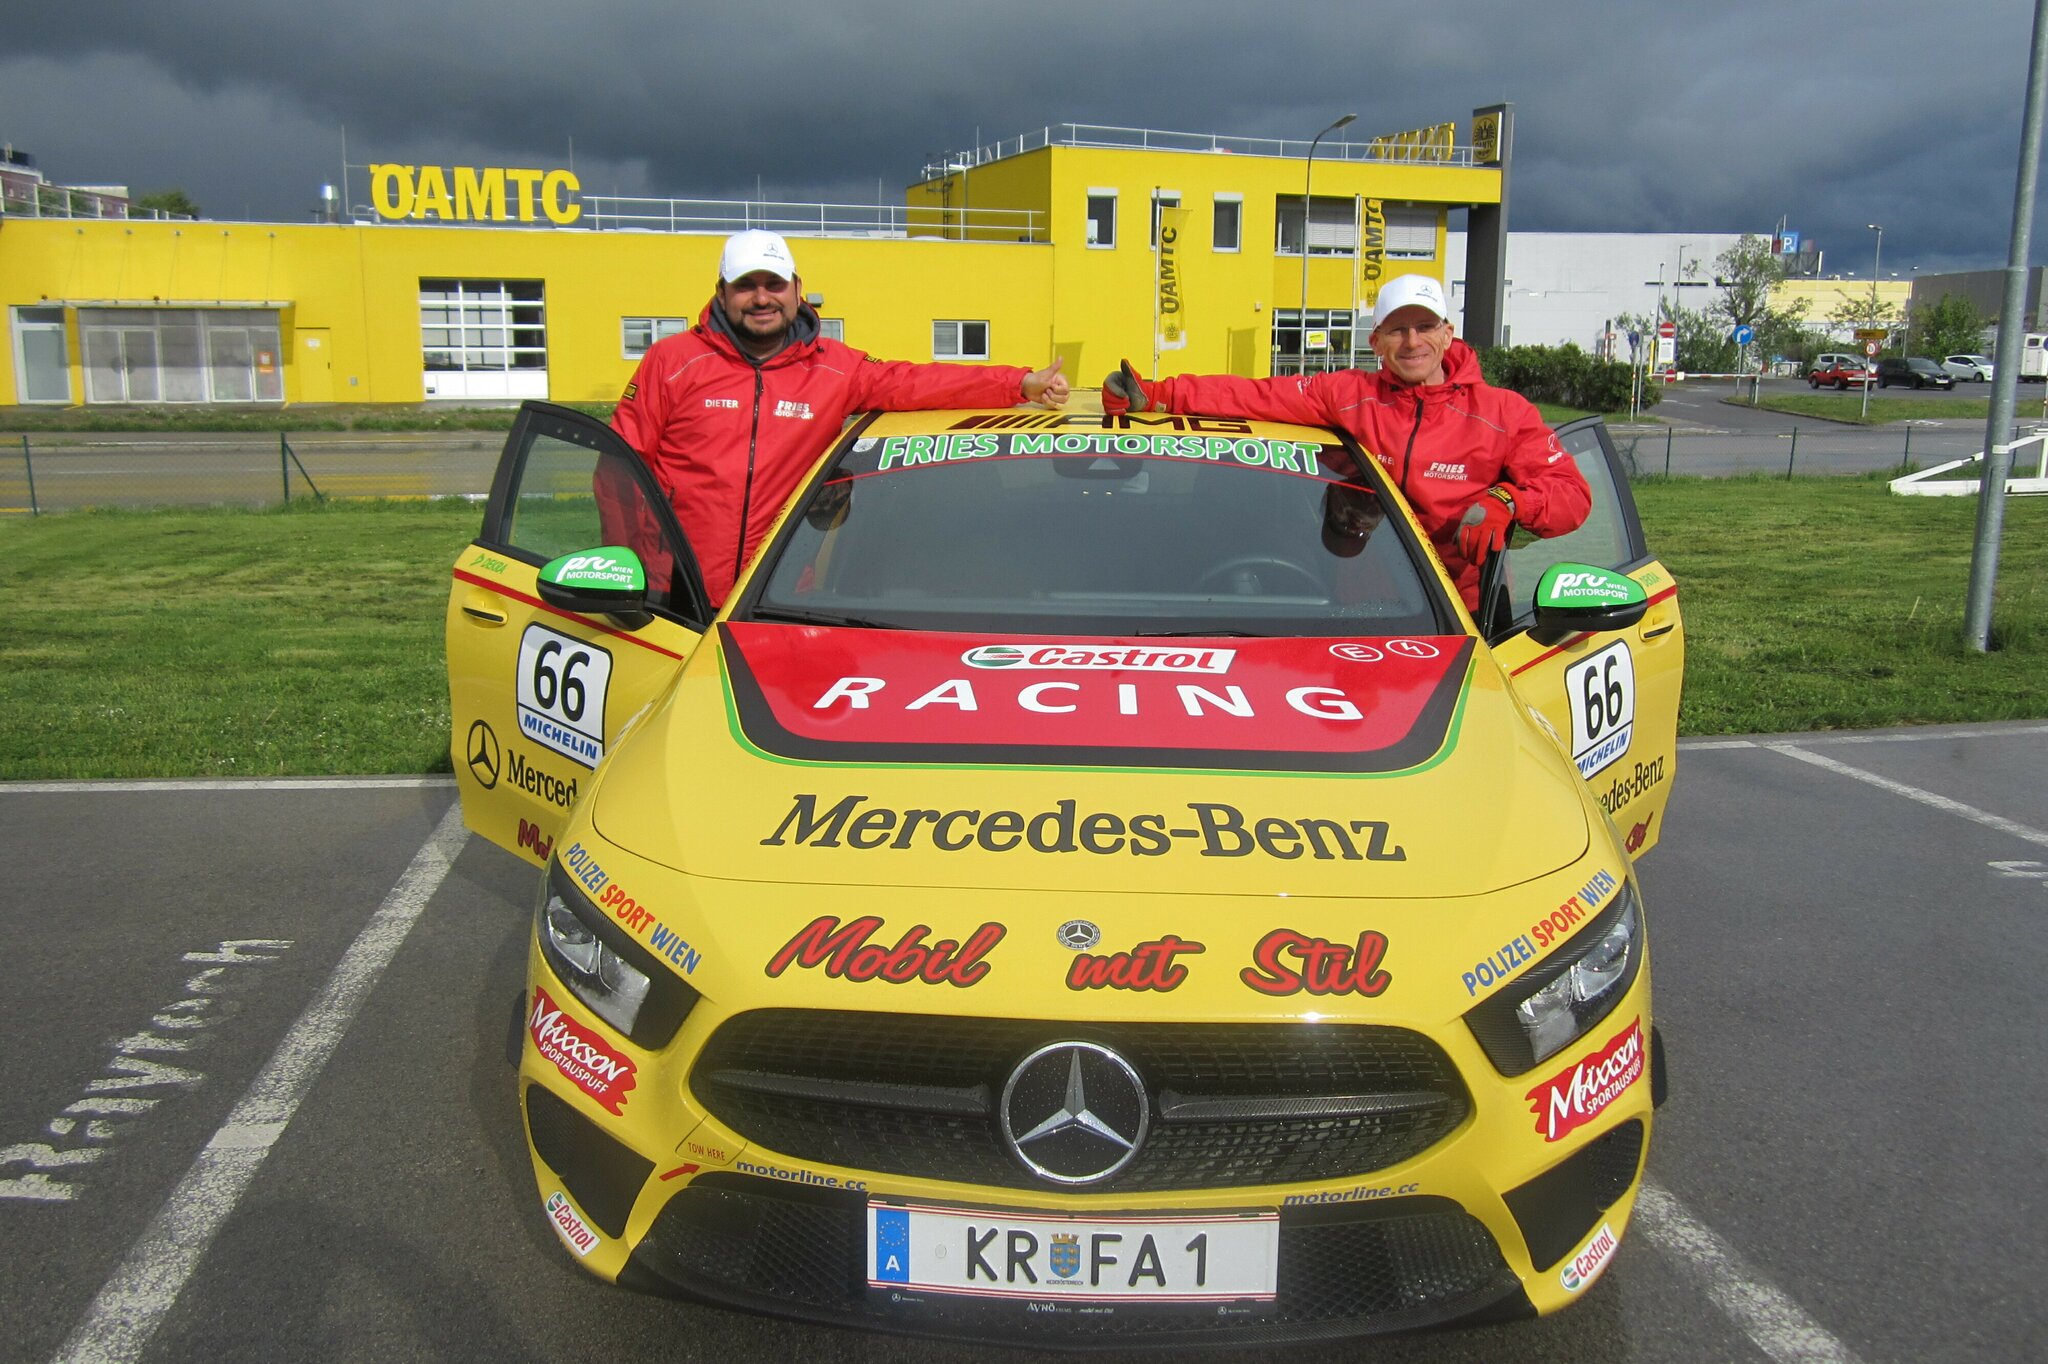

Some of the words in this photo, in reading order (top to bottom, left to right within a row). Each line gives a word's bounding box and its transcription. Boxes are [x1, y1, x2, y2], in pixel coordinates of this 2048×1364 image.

[370, 163, 581, 224] ÖAMTC
[1160, 226, 1177, 315] ÖAMTC
[705, 399, 739, 409] DIETER
[777, 400, 810, 412] FRIES
[1044, 414, 1253, 434] AMG
[878, 434, 999, 471] FRIES
[1010, 433, 1323, 475] MOTORSPORT
[1423, 471, 1468, 481] MOTORSPORT
[1430, 462, 1465, 473] FRIES
[566, 571, 633, 583] MOTORSPORT
[611, 565, 634, 574] WIEN
[1606, 582, 1628, 592] WIEN
[1563, 588, 1629, 600] MOTORSPORT
[1028, 647, 1215, 670] Castrol
[534, 640, 590, 722] 66
[813, 677, 1364, 721] RACING
[1584, 655, 1623, 740] 66
[524, 714, 598, 760] MICHELIN
[1577, 730, 1628, 774] MICHELIN
[760, 794, 1407, 862] Mercedes-Benz
[564, 842, 608, 895] POLIZEI
[600, 884, 655, 934] SPORT
[650, 923, 702, 975] WIEN
[1461, 933, 1537, 997] POLIZEI
[1532, 896, 1586, 947] SPORT
[1579, 868, 1616, 907] WIEN
[765, 915, 1006, 987] Mobil
[1066, 934, 1205, 992] mit
[1239, 928, 1392, 998] Stil
[540, 1041, 609, 1094] SPORTAUSPUFF
[1586, 1055, 1641, 1115] SPORTAUSPUFF
[687, 1141, 705, 1158] TOW
[706, 1146, 726, 1162] HERE
[736, 1159, 867, 1192] motorline.cc
[1283, 1182, 1420, 1206] motorline.cc
[553, 1201, 596, 1251] Castrol
[886, 1255, 900, 1272] A
[967, 1226, 1039, 1284] KR
[1574, 1230, 1616, 1279] Castrol
